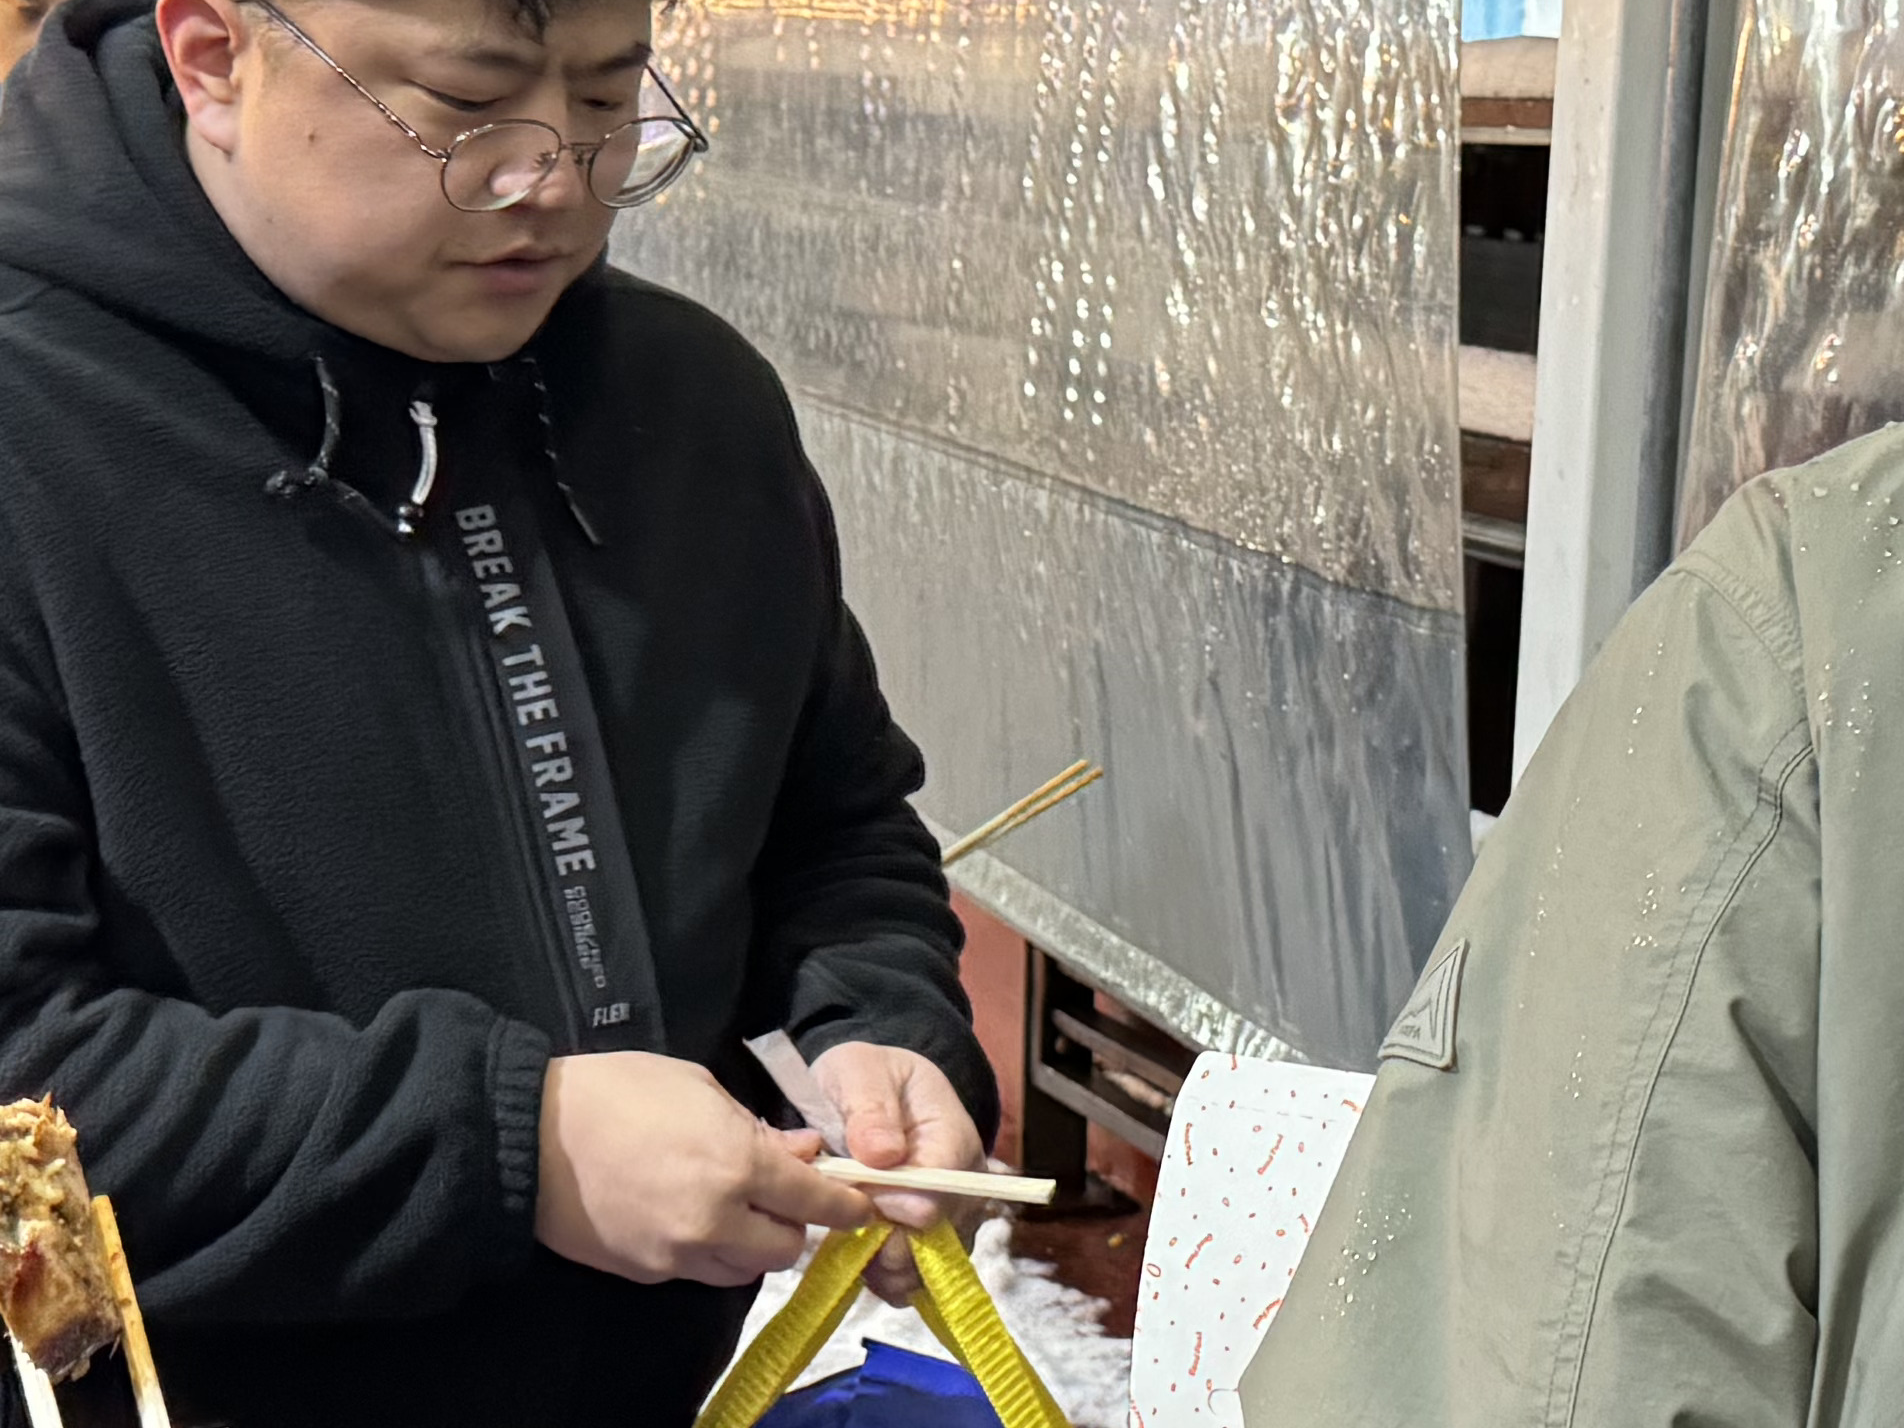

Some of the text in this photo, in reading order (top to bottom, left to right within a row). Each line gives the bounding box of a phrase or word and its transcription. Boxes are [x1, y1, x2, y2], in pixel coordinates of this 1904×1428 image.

[454, 503, 533, 636] BREAK
[501, 643, 560, 727] THE
[524, 731, 597, 877] FRAME
